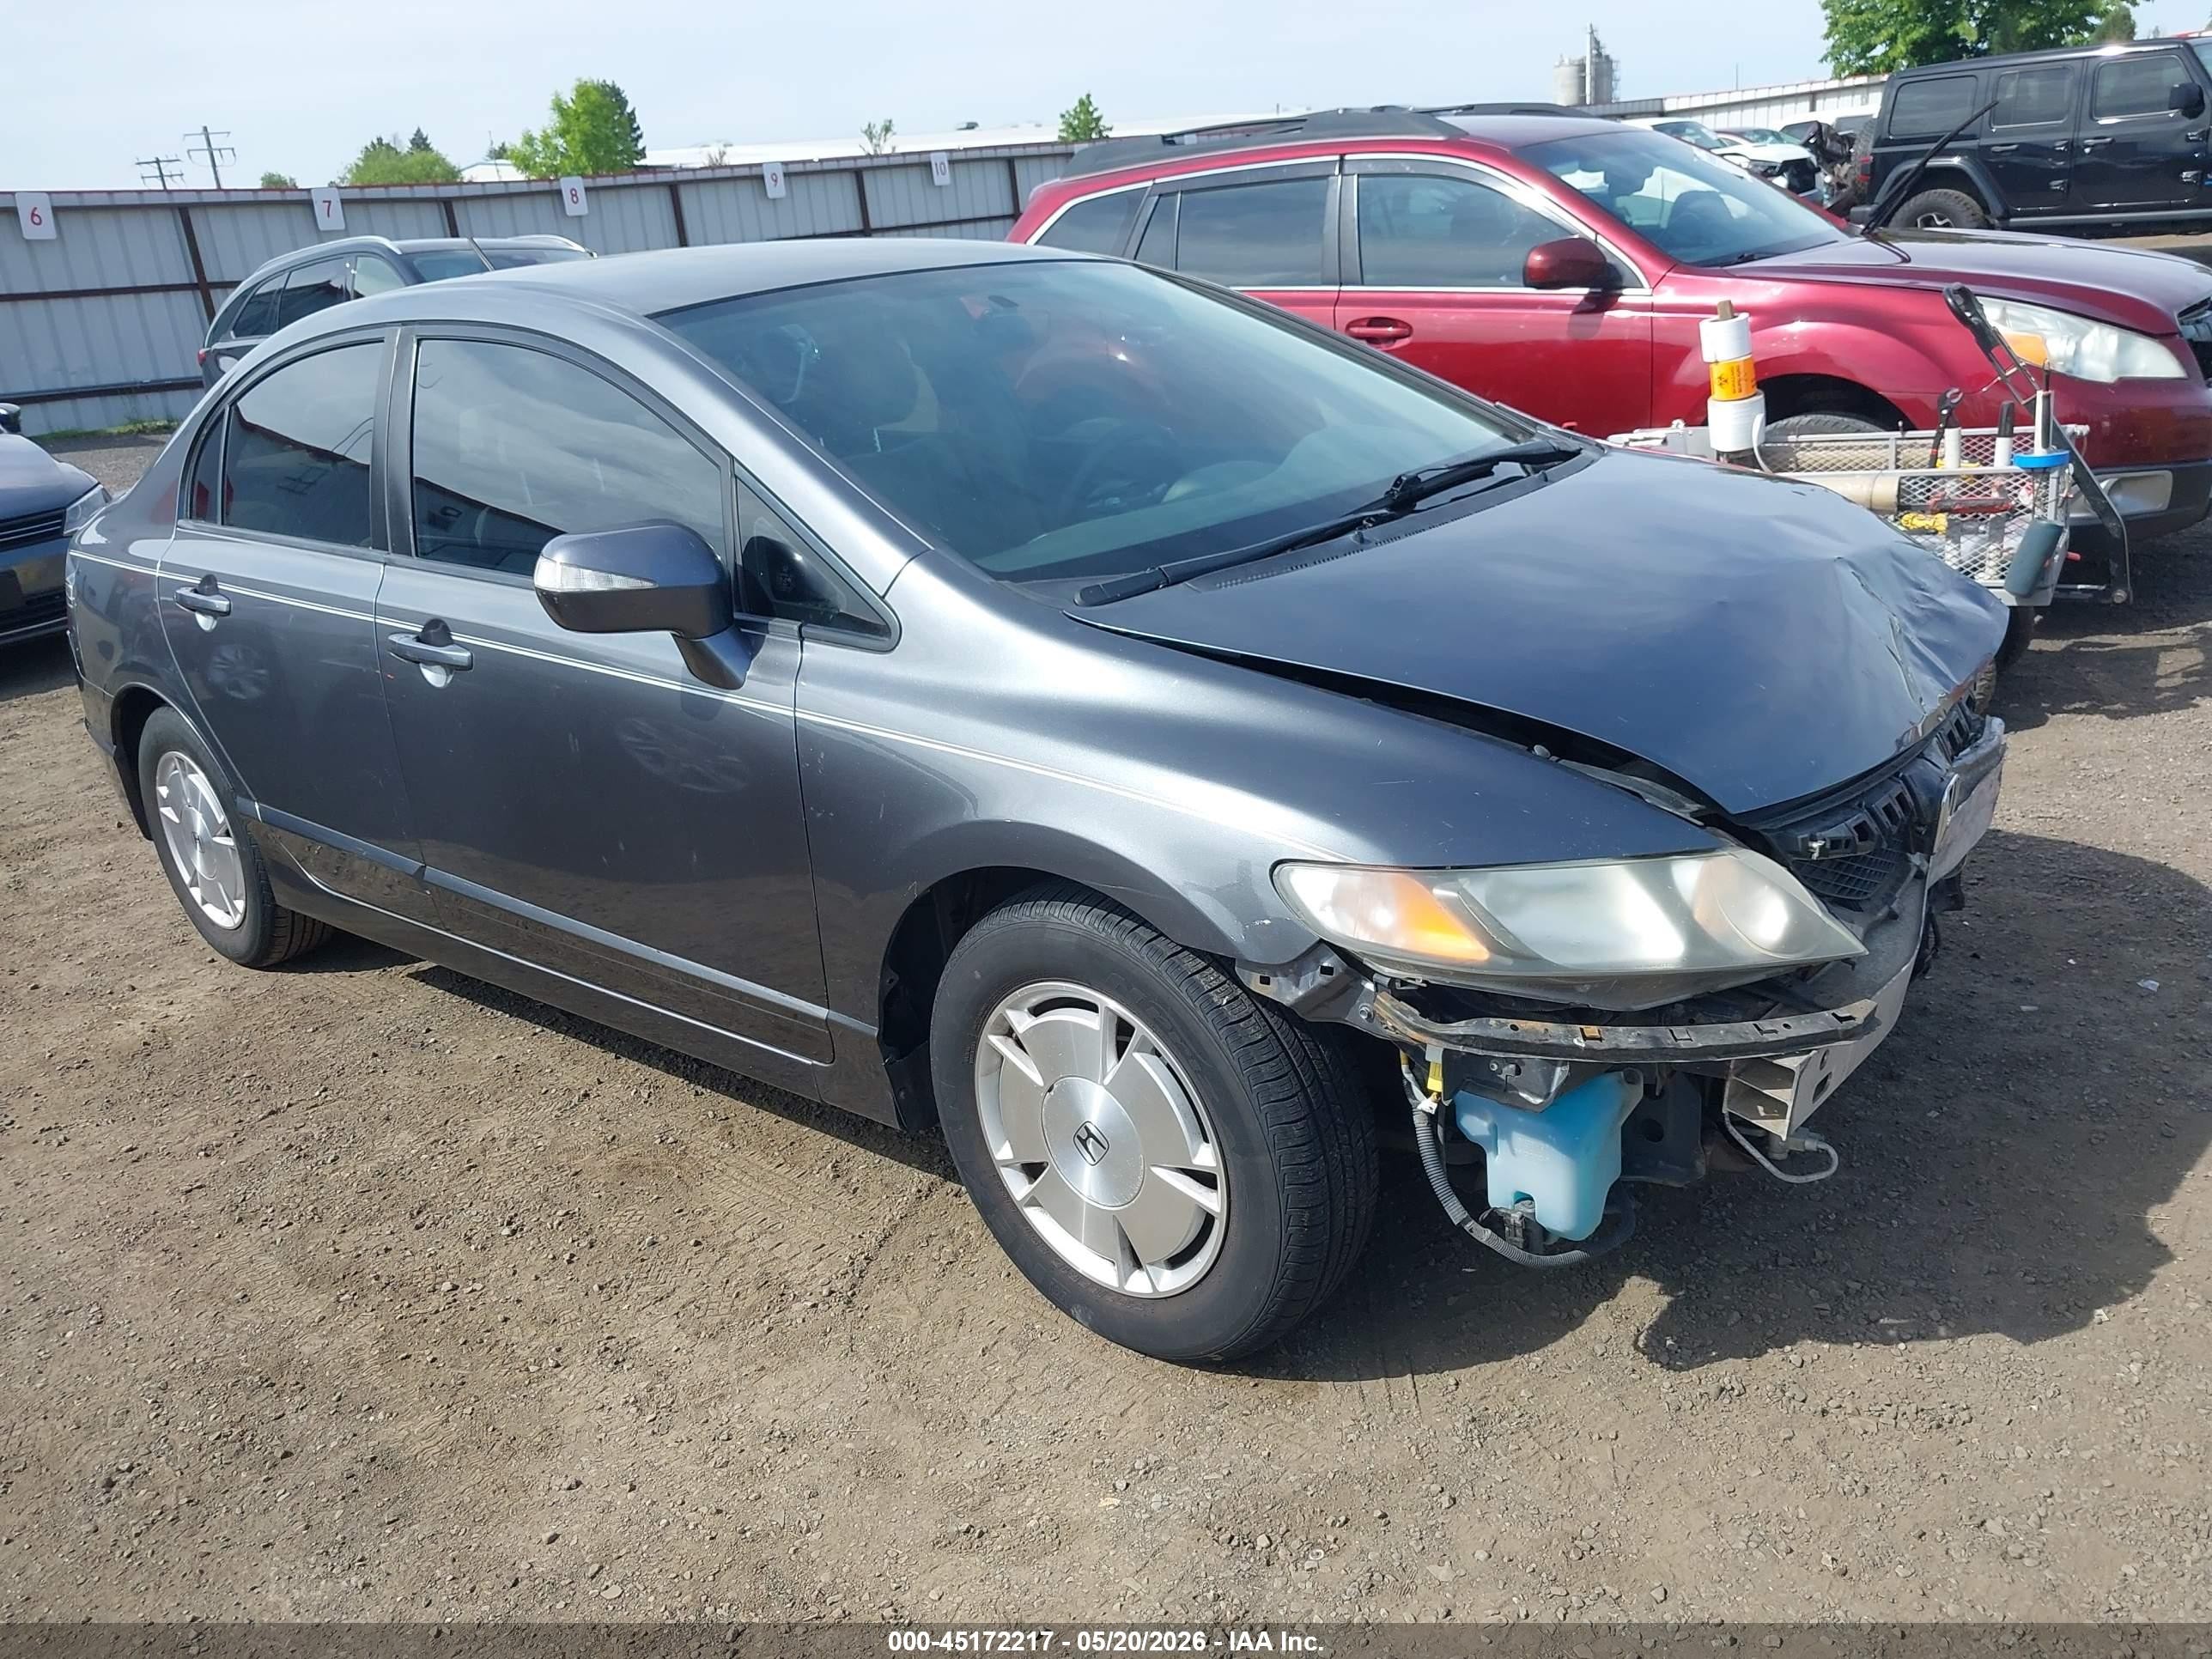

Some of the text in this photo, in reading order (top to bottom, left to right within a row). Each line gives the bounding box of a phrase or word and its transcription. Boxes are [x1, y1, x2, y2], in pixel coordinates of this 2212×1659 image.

[935, 161, 946, 176] 10
[770, 172, 778, 187] 9
[569, 187, 579, 204] 8
[31, 206, 42, 226] 6
[322, 199, 331, 218] 7
